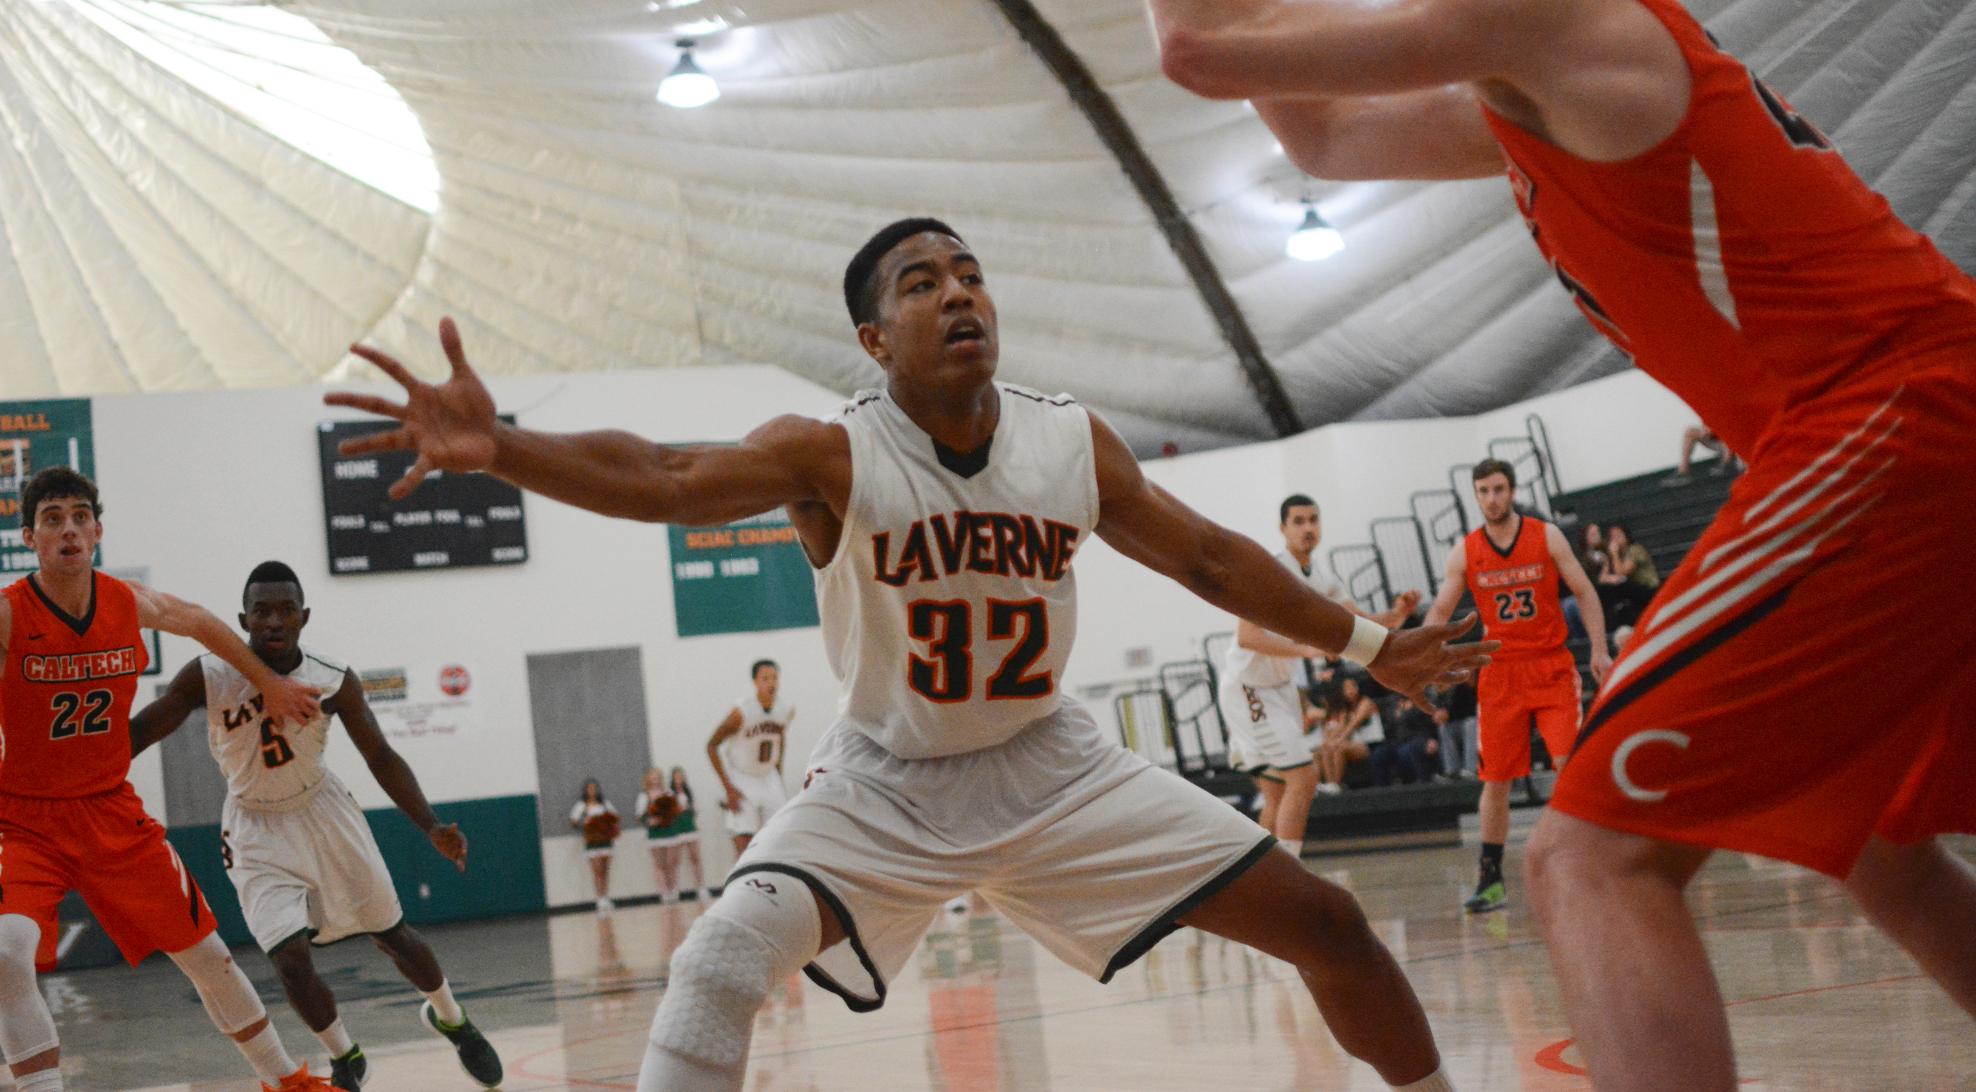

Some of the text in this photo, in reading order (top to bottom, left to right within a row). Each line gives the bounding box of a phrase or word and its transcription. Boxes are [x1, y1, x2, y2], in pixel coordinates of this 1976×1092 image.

[334, 459, 379, 479] HOME
[872, 510, 1080, 587] LAVERNE
[1495, 587, 1537, 623] 23
[22, 646, 137, 682] CALTECH
[907, 596, 1054, 704] 32
[50, 688, 113, 742] 22
[260, 716, 294, 769] 5
